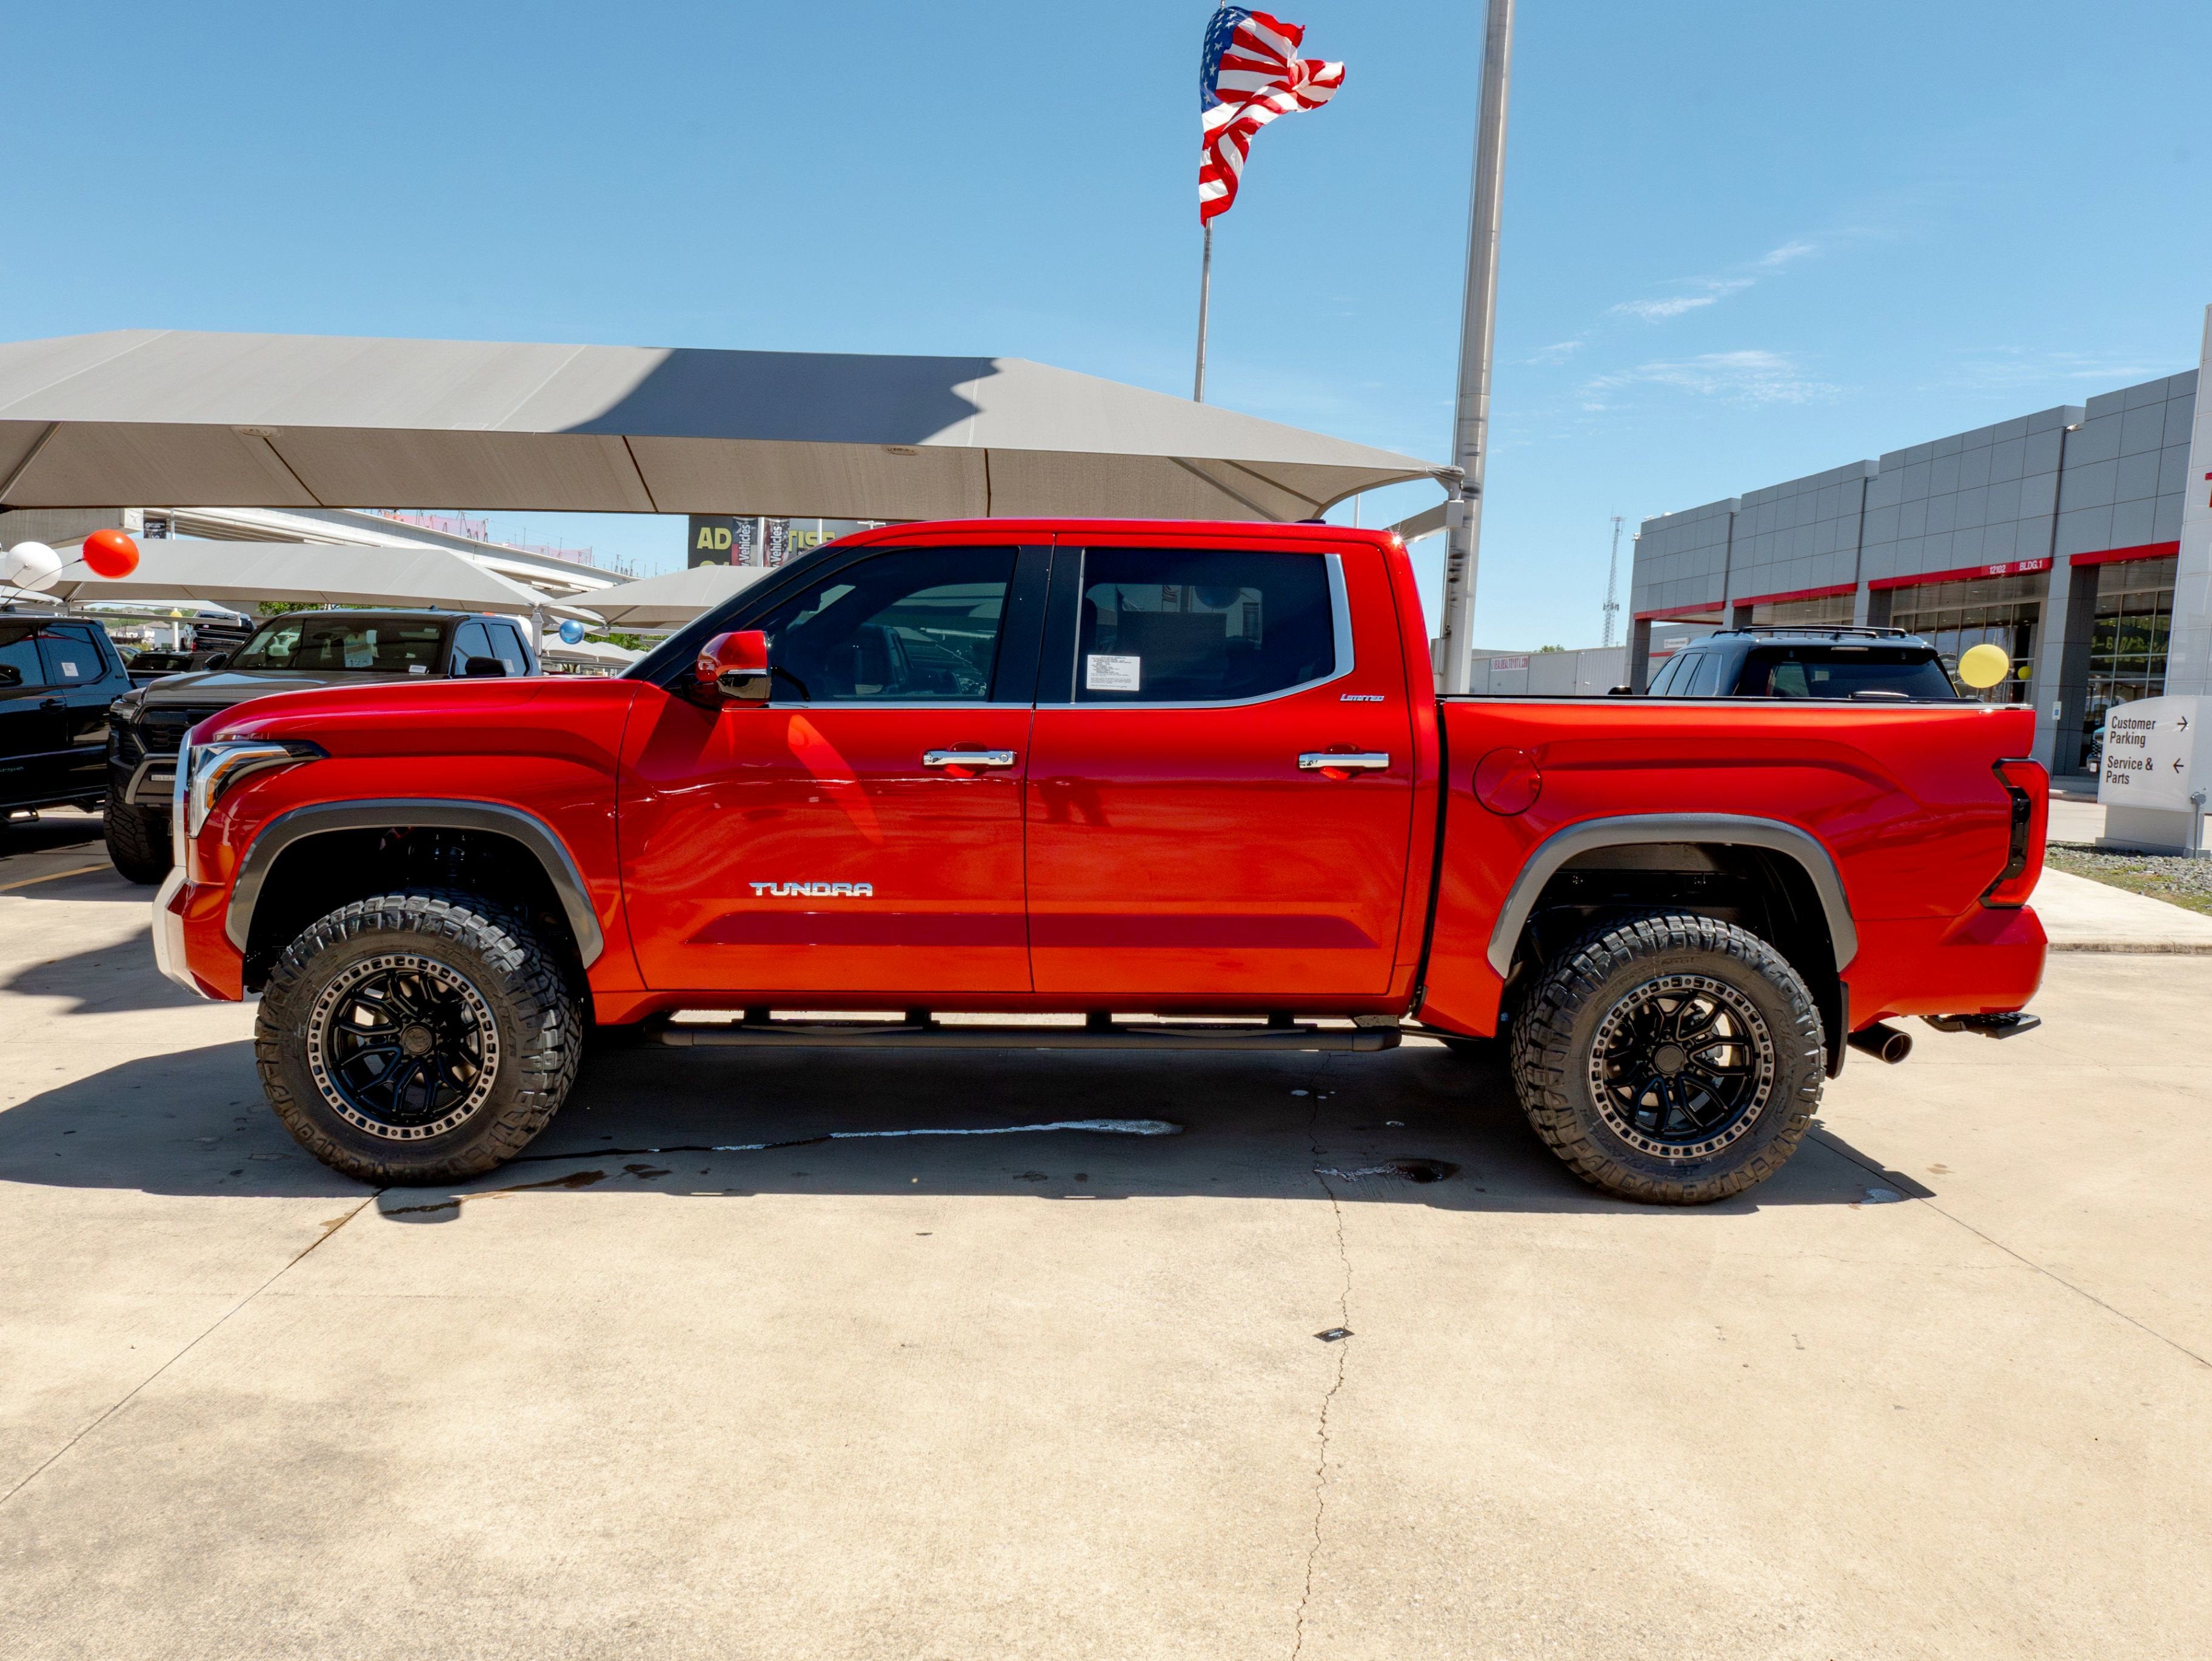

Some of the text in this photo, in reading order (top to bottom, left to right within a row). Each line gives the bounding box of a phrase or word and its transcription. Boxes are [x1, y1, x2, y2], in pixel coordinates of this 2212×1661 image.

[738, 524, 751, 561] Vehicles
[769, 526, 783, 563] Vehicles
[1990, 564, 2006, 574] 12102
[2111, 715, 2156, 730] Customer
[2110, 731, 2146, 748] Parking
[2107, 755, 2153, 771] Service &
[2106, 770, 2130, 784] Parts
[749, 882, 873, 897] TUNDRA
